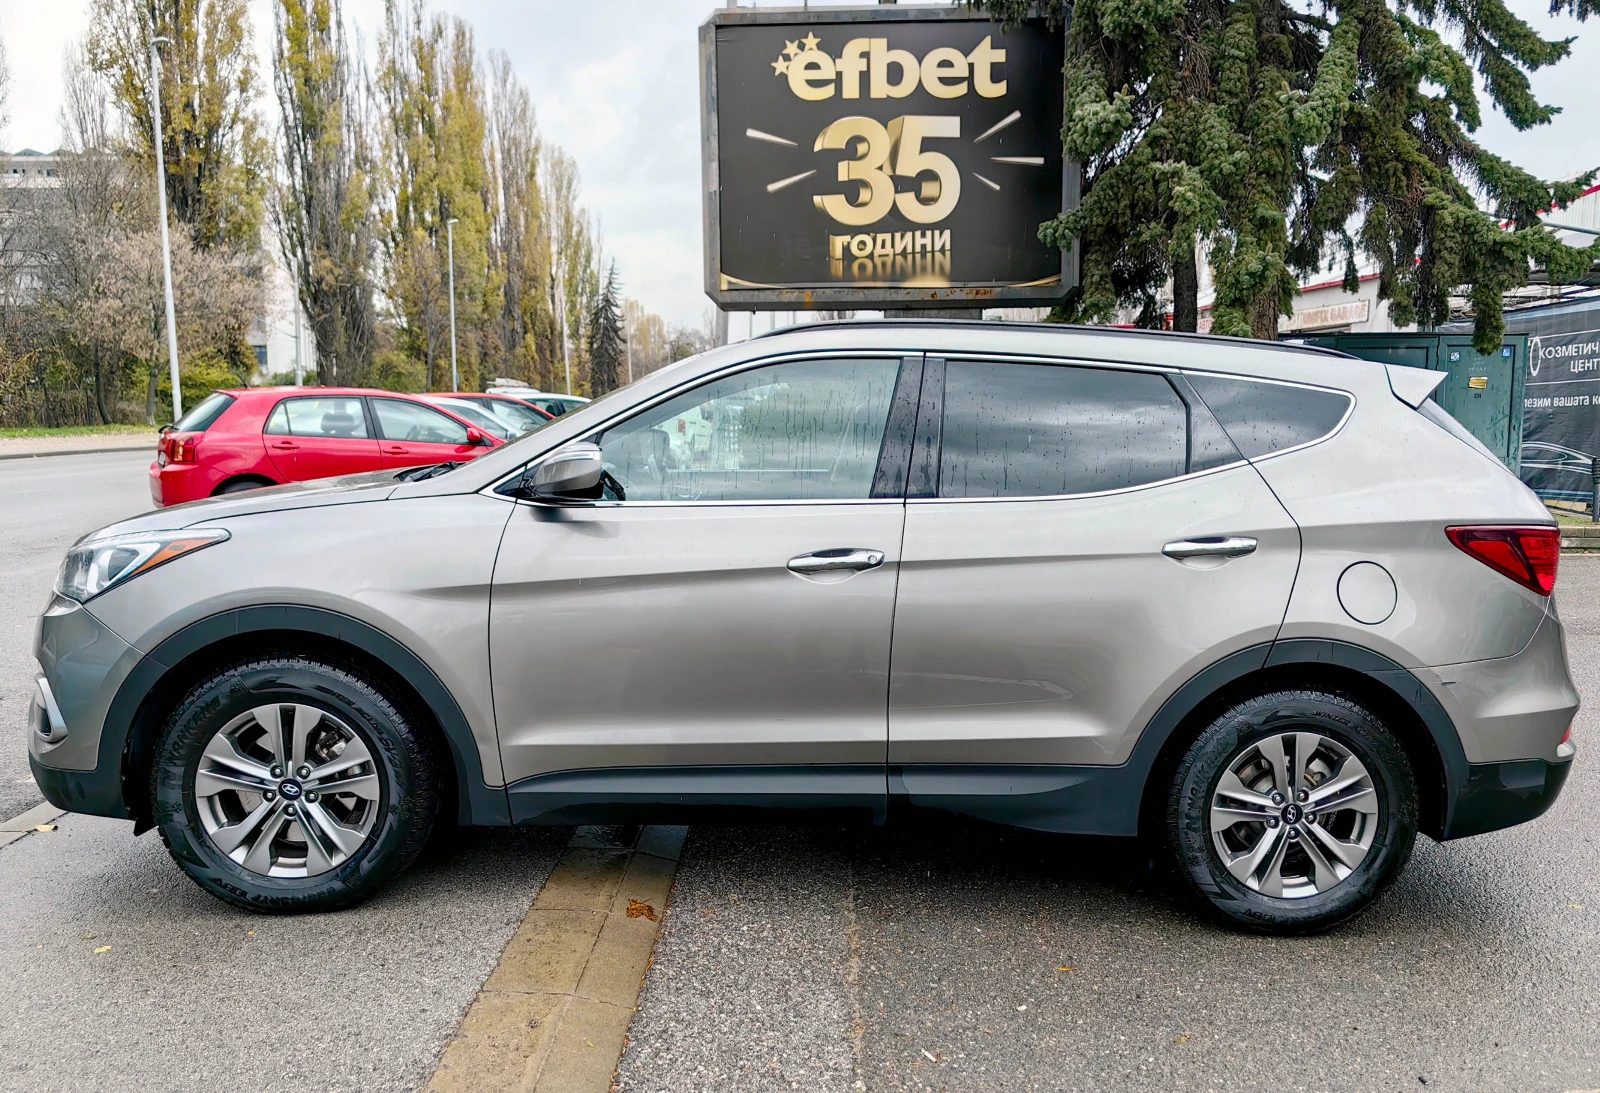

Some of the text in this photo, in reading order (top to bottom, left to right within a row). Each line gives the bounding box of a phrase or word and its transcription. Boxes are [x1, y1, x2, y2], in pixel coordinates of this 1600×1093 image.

[787, 35, 1008, 101] efbet
[813, 115, 961, 226] 35
[1540, 341, 1599, 359] КОЗМЕТИЧ
[1570, 358, 1600, 374] ЦЕНТ
[1553, 395, 1590, 407] вашата
